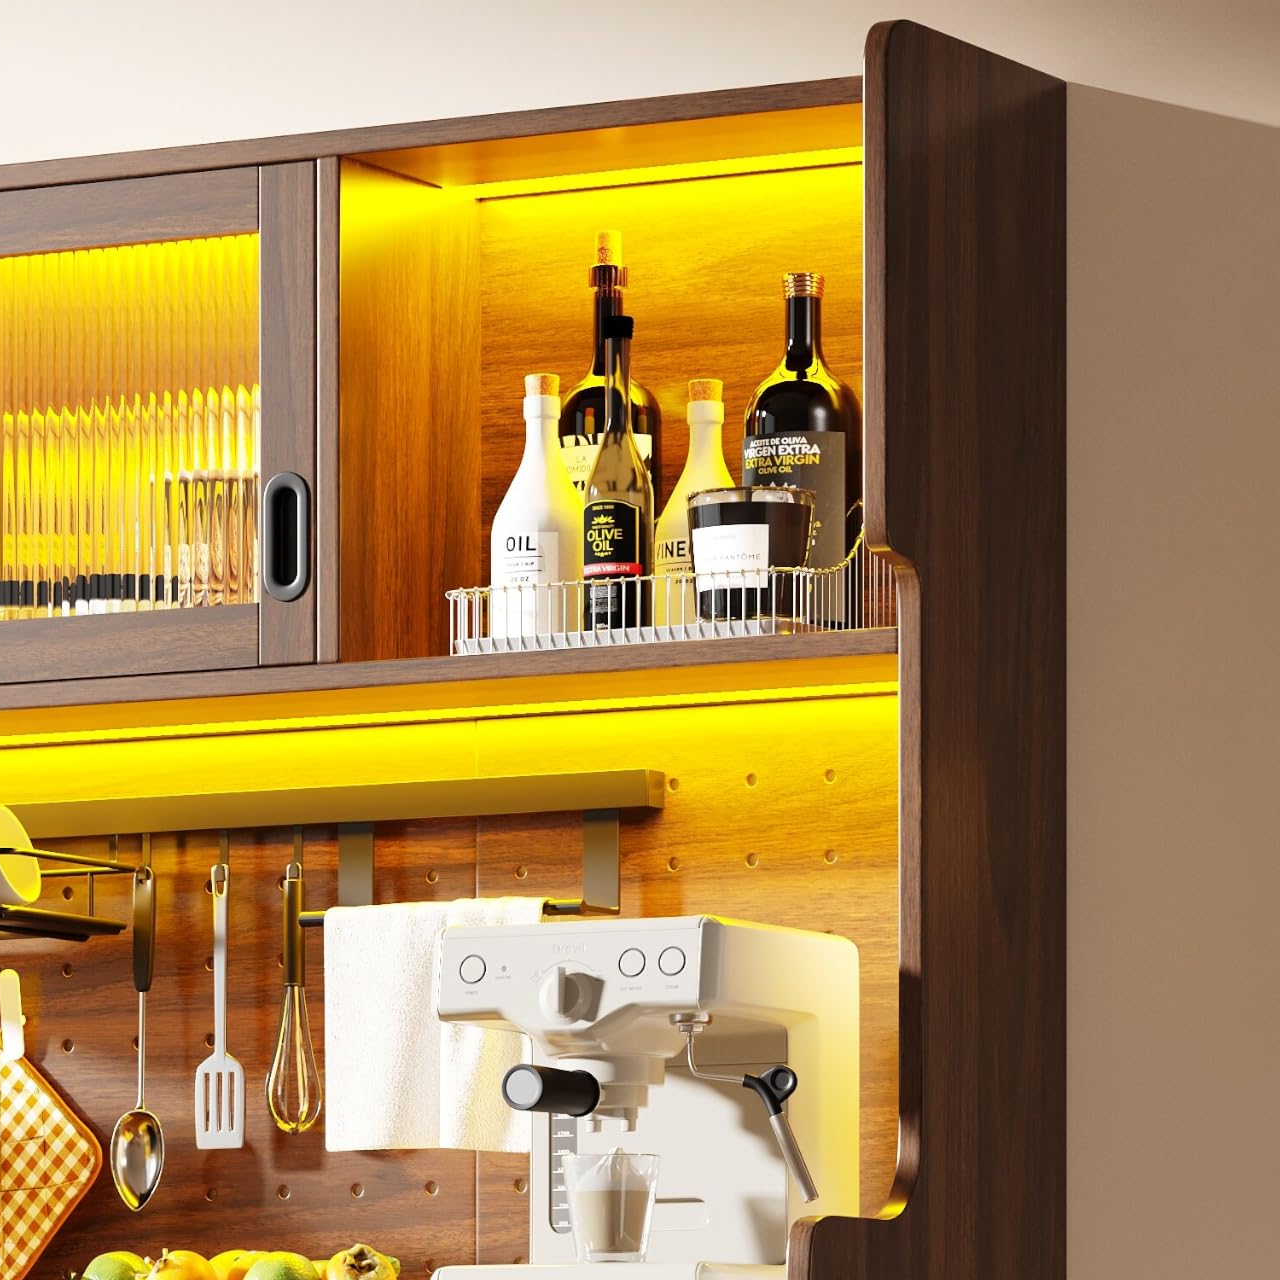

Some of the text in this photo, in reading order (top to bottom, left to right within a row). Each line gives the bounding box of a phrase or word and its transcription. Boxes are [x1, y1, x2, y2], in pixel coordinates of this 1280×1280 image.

[749, 436, 808, 449] ACEITE DE OLIVA
[743, 443, 822, 460] VIRGEN EXTRA
[745, 454, 820, 470] EXTRA VIRGIN
[758, 465, 793, 475] OLIVE OIL
[586, 528, 624, 542] OLIVE
[506, 535, 537, 552] OIL
[592, 540, 614, 552] OIL
[656, 540, 687, 560] VINE
[601, 564, 631, 573] VIRGIN
